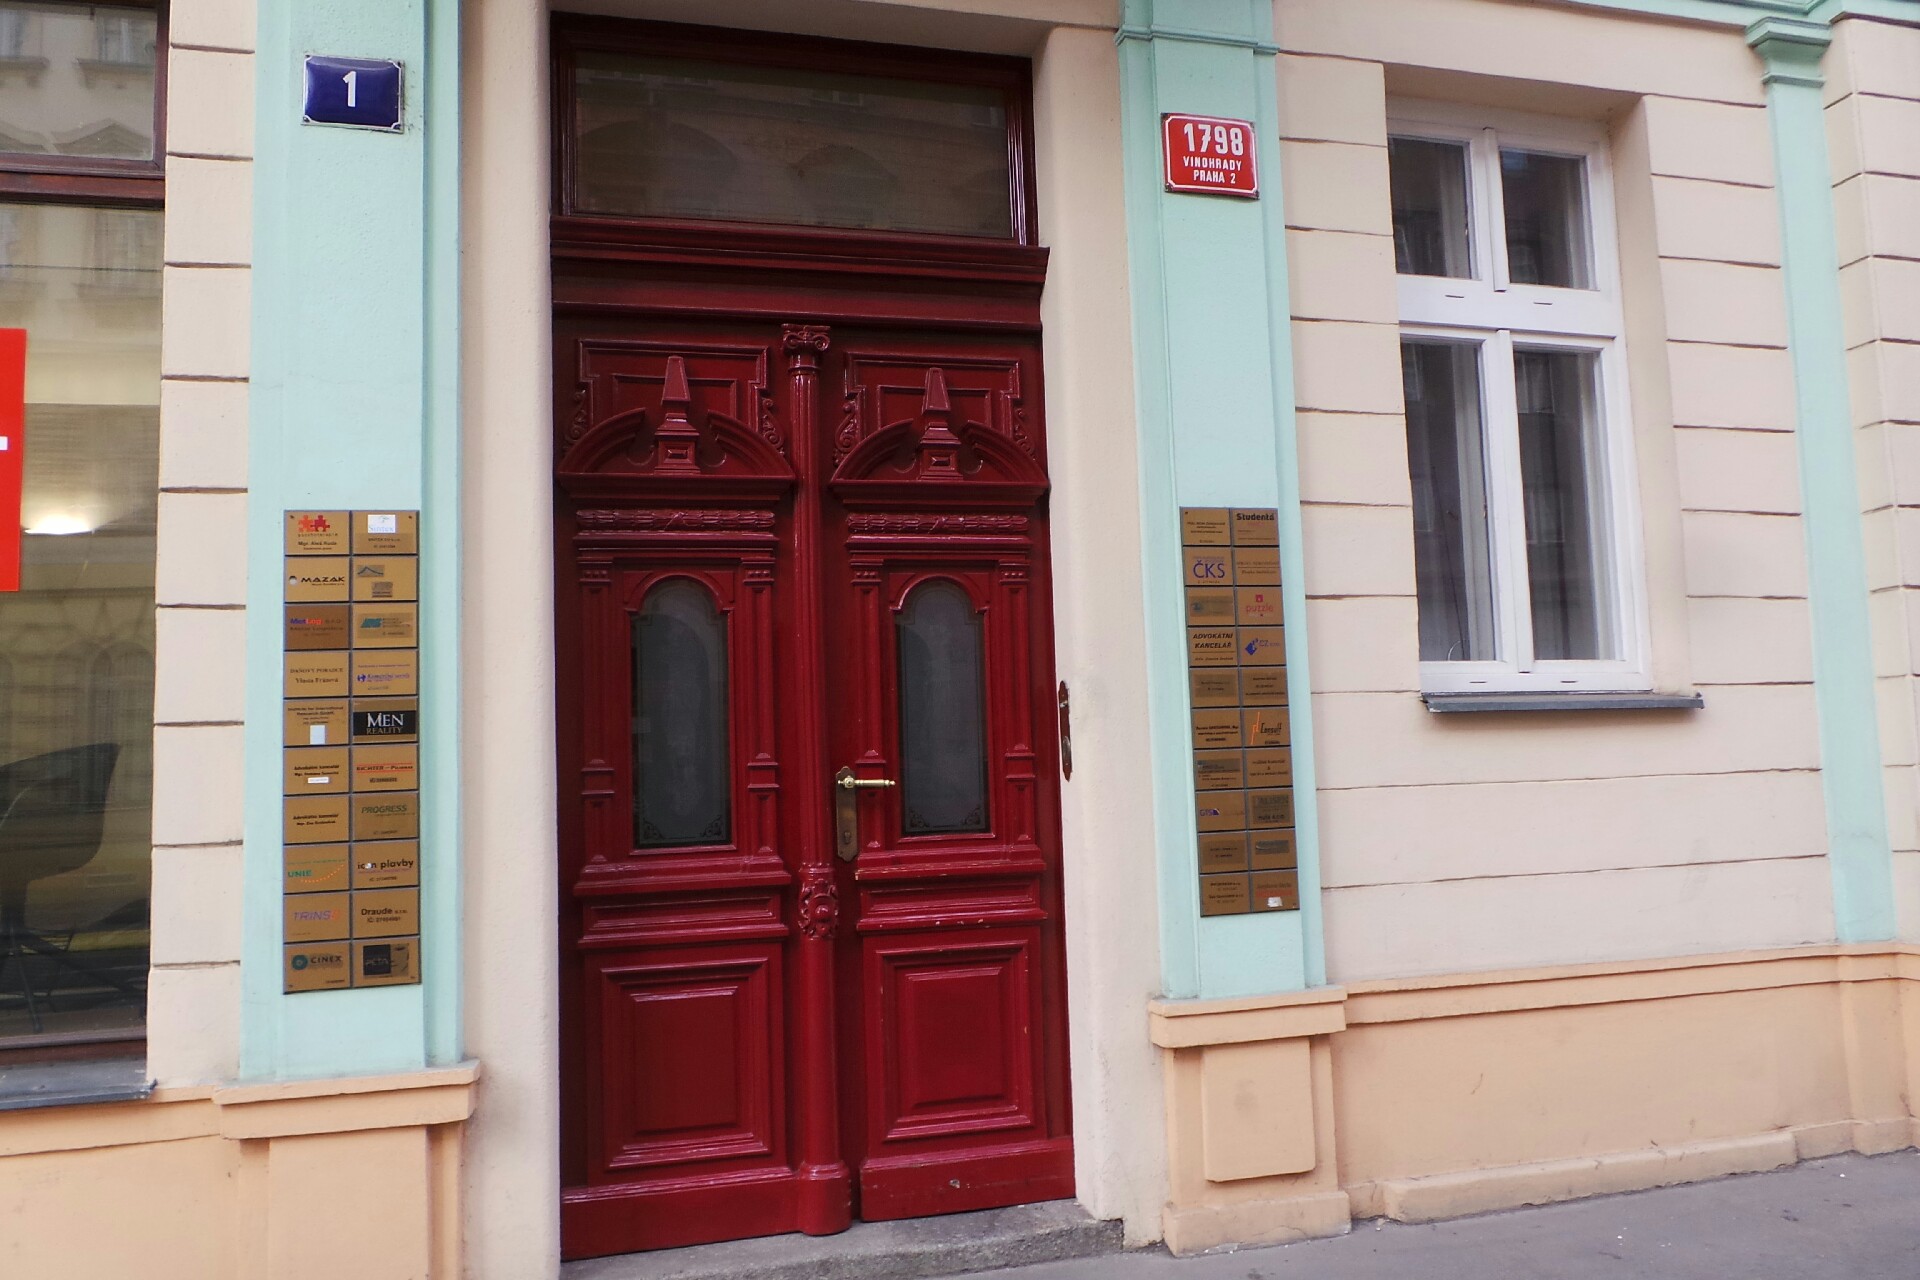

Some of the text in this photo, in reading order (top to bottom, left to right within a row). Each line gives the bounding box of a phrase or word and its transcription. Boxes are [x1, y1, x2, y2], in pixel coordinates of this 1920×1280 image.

[343, 70, 356, 107] 1
[1184, 123, 1244, 156] 1798
[1183, 156, 1242, 171] VINOHRADY
[1193, 170, 1236, 184] PRAHA 2
[1193, 560, 1225, 579] ČKS
[367, 712, 404, 728] MEN
[366, 727, 403, 735] REALITY
[361, 804, 407, 814] PROGRESS
[380, 858, 414, 871] plavby
[361, 907, 393, 916] Draude
[310, 955, 342, 964] CINEX
